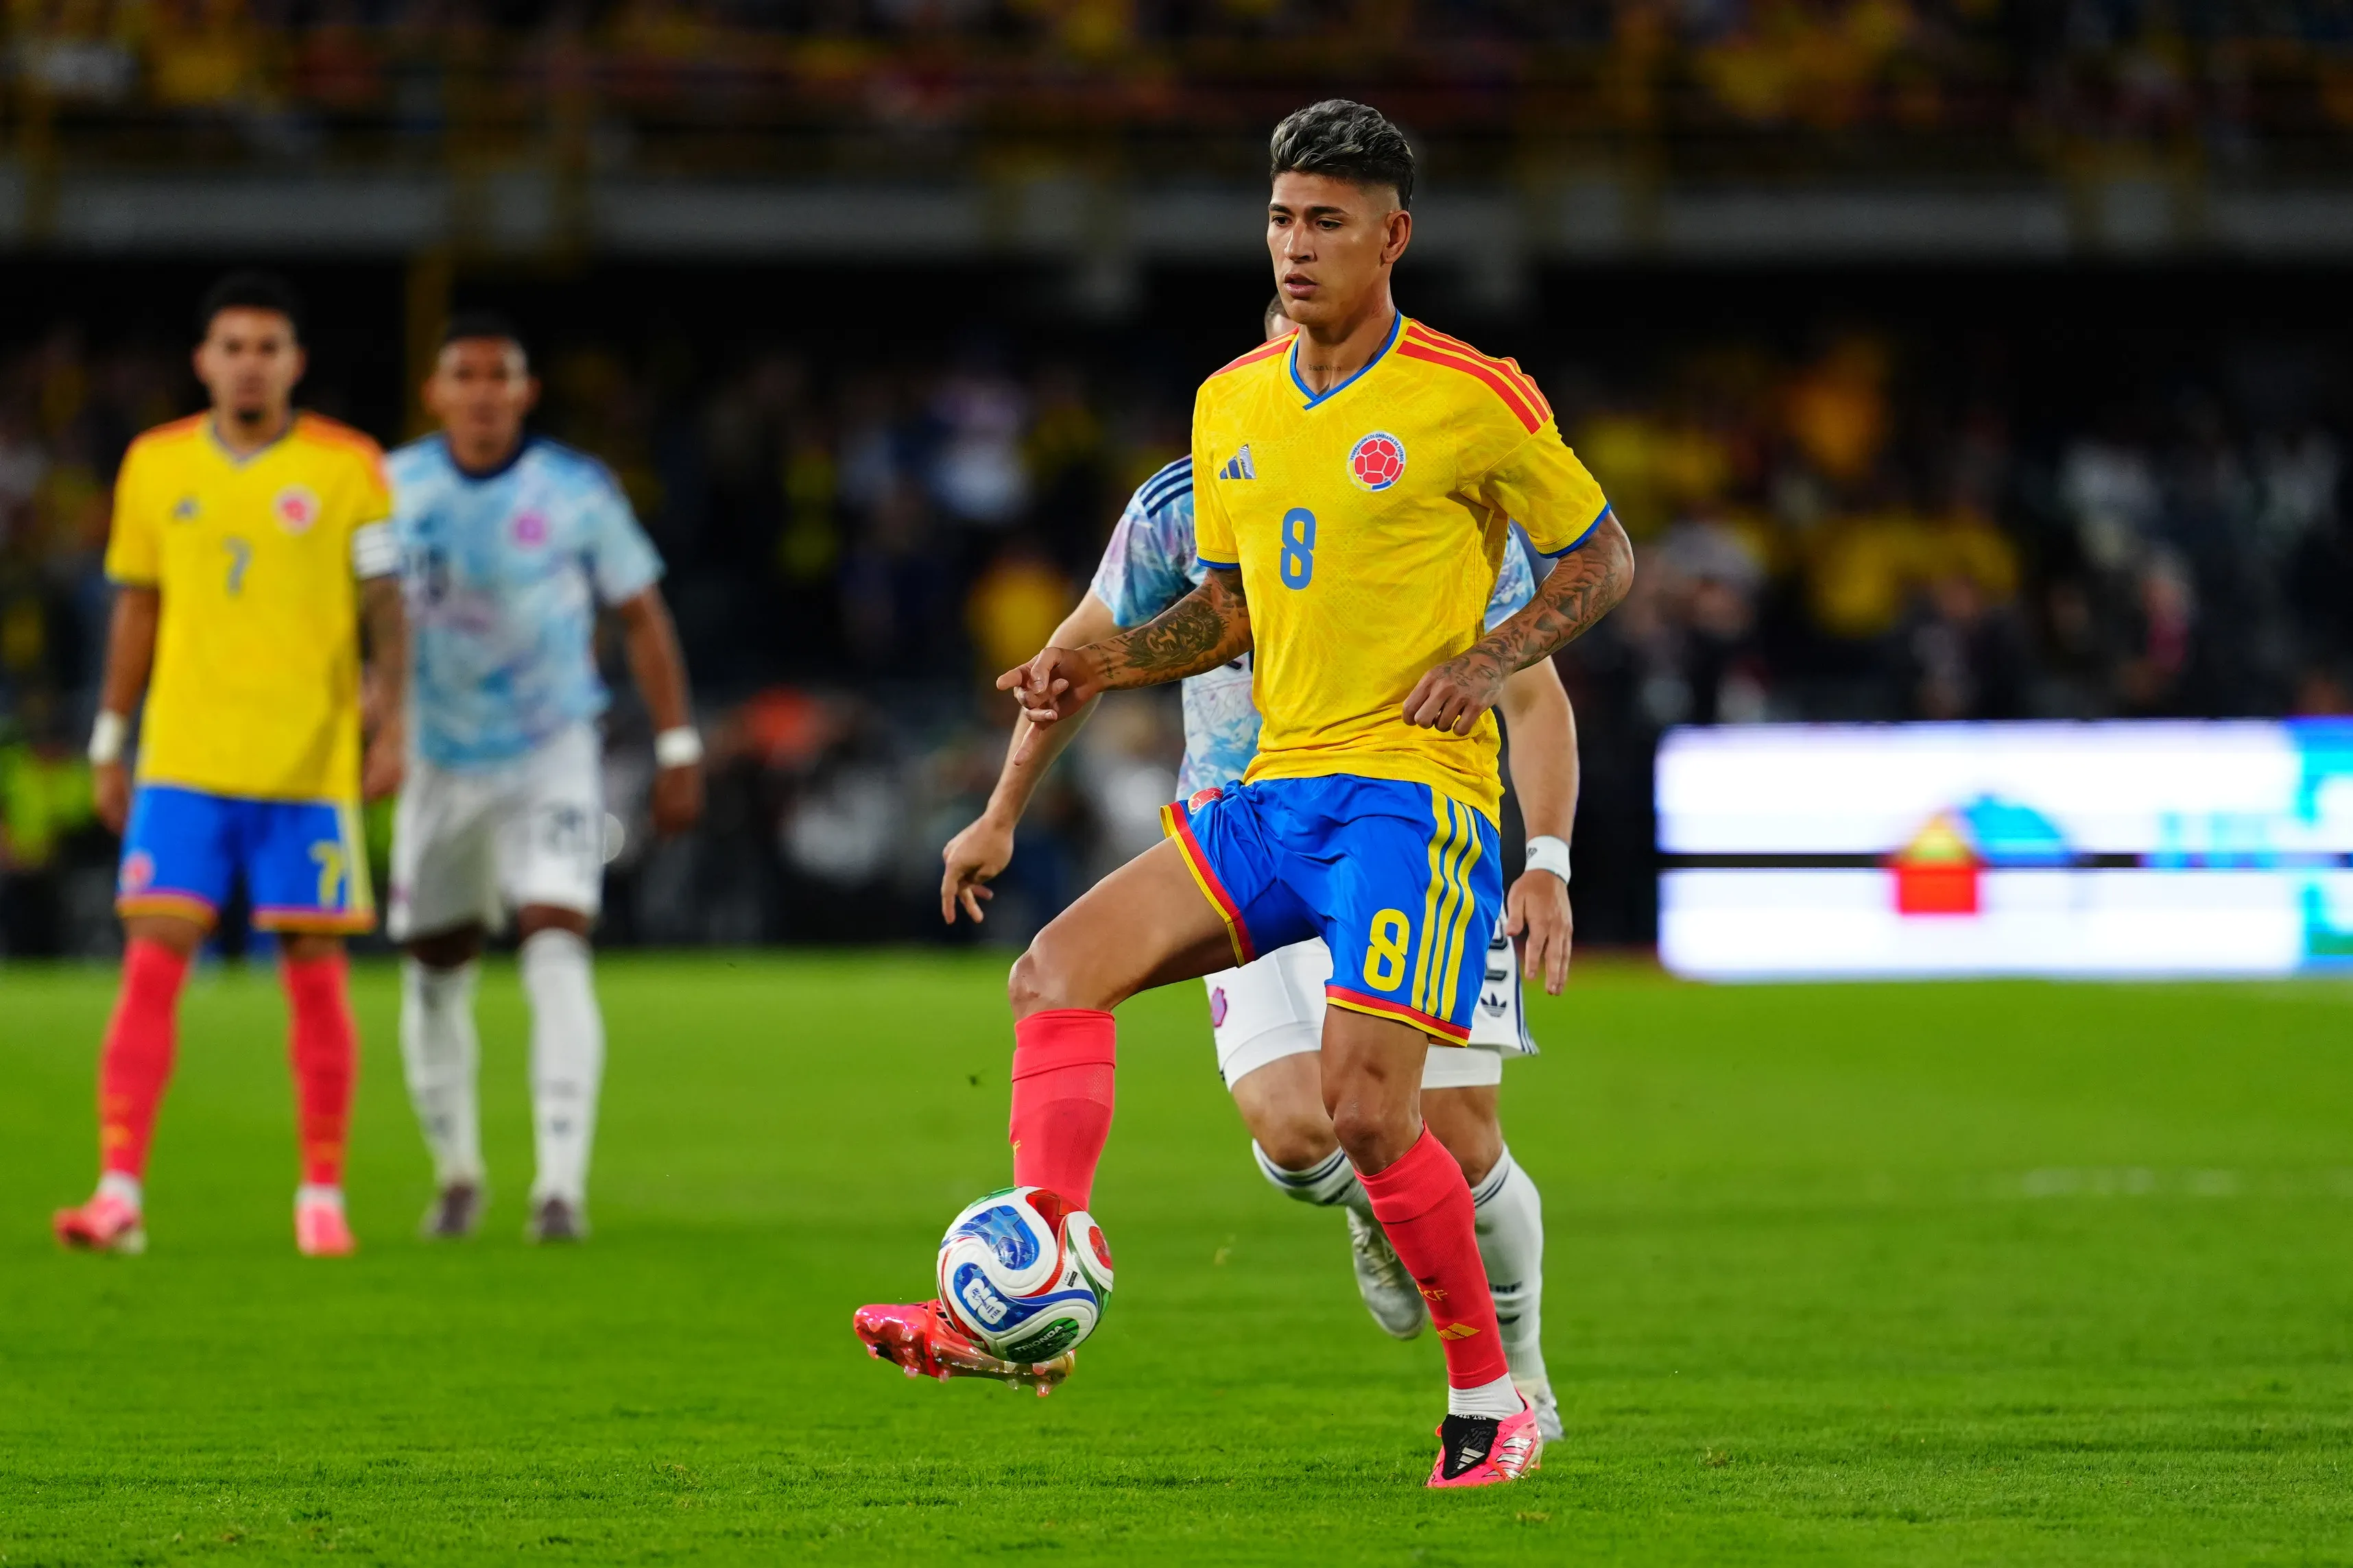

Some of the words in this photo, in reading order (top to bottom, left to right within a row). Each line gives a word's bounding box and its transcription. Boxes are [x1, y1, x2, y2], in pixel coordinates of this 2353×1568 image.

[1367, 433, 1395, 442] COLOMBIANA
[222, 536, 253, 595] 7
[1280, 507, 1317, 590] 8
[309, 839, 346, 907] 7
[1362, 908, 1411, 992] 8
[990, 1309, 1001, 1319] FIFA
[1014, 1325, 1064, 1352] TRIONDA
